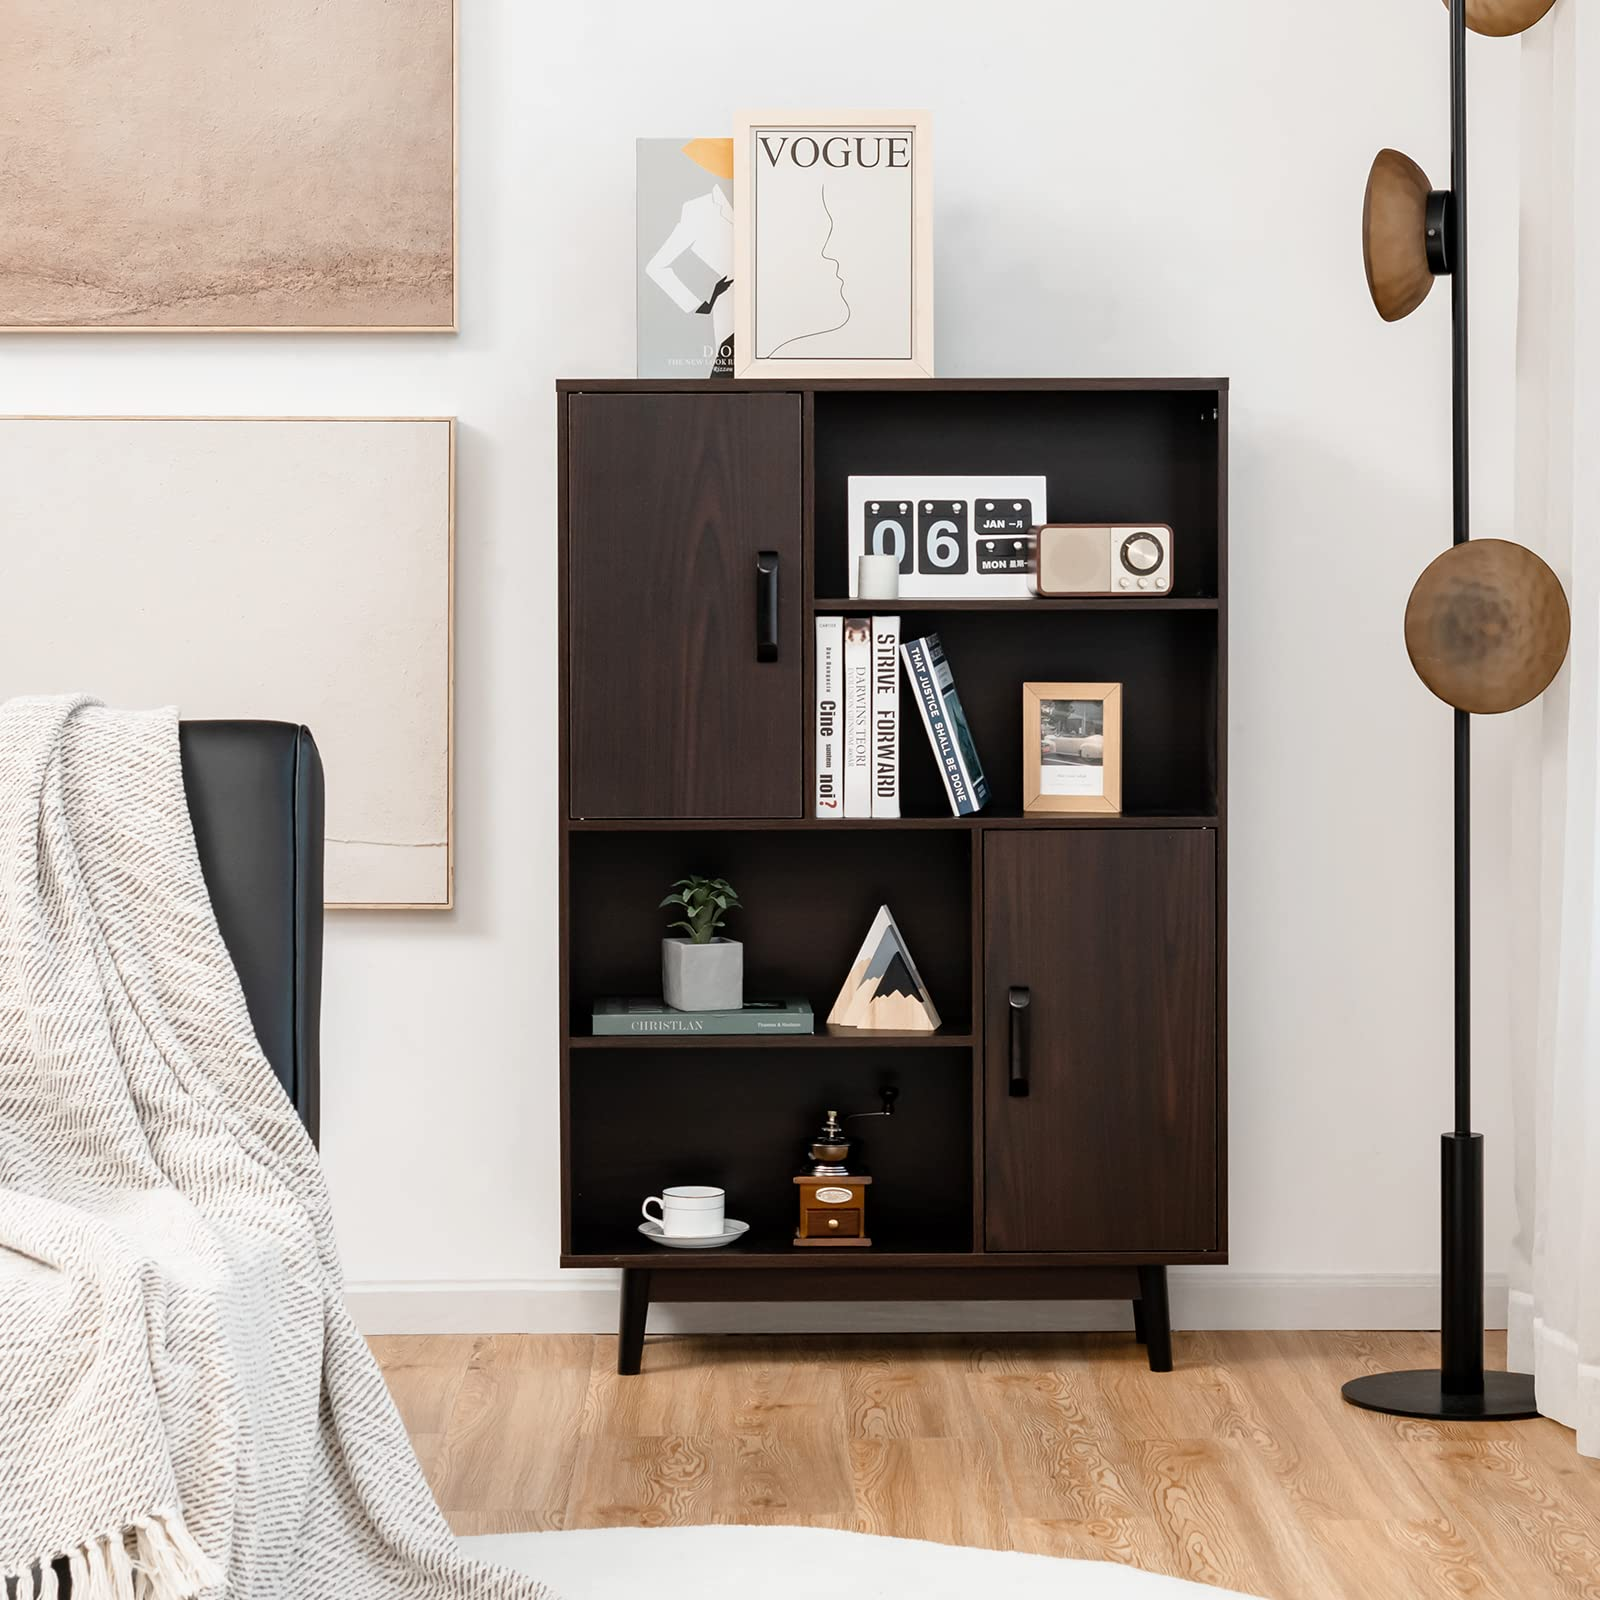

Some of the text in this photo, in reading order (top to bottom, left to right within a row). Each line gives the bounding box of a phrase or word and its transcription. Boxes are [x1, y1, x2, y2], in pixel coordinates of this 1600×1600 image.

[758, 136, 910, 168] VOGUE
[983, 519, 1023, 529] JAN 一月
[982, 560, 1007, 570] MON
[911, 647, 926, 673] THAT
[920, 674, 939, 717] JUSTICE
[820, 700, 836, 737] Cine
[856, 666, 867, 767] DARWINS TEORI
[877, 634, 896, 797] STRIVE FORWARD
[934, 722, 951, 756] SHALL
[946, 757, 957, 772] BE
[819, 774, 838, 809] noi?
[951, 773, 967, 802] DONE
